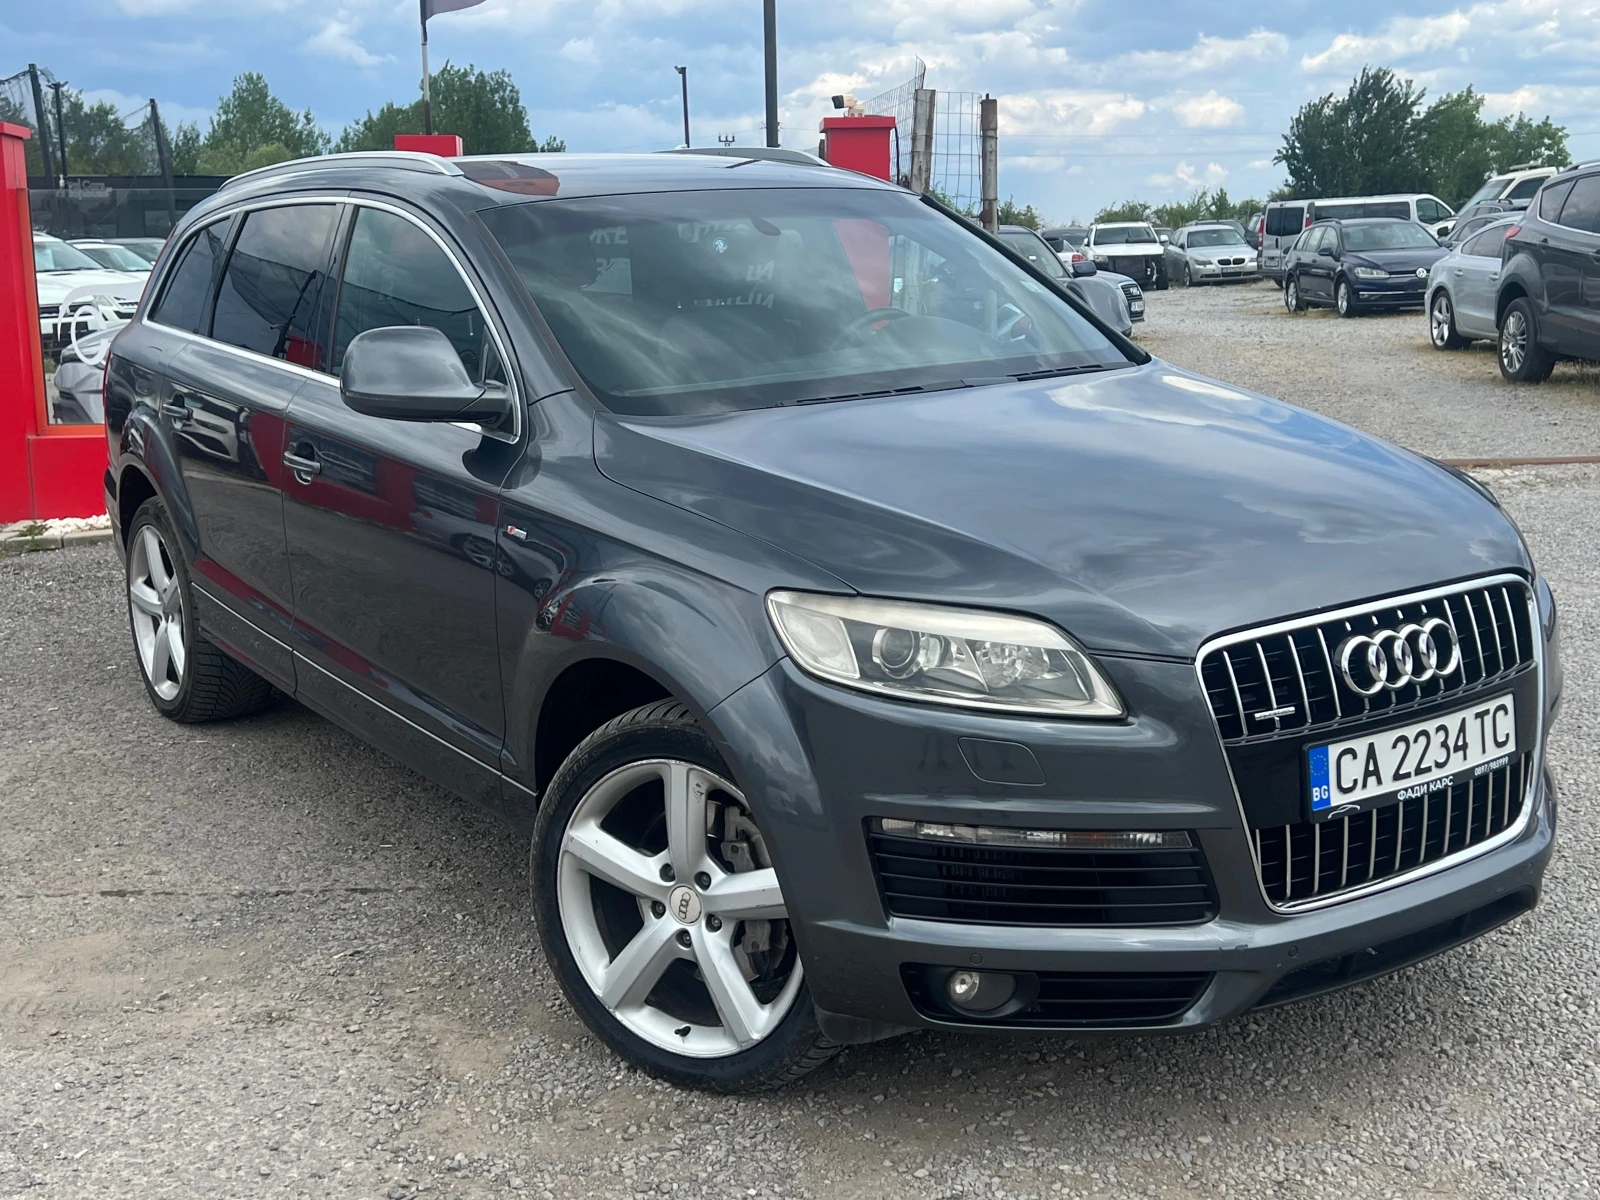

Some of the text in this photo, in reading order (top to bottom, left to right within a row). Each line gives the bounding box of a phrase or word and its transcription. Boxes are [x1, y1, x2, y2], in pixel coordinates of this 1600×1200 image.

[1336, 704, 1510, 794] CA 2234 TC
[1312, 785, 1329, 802] BG
[1397, 776, 1453, 800] ФАДИ КАРС
